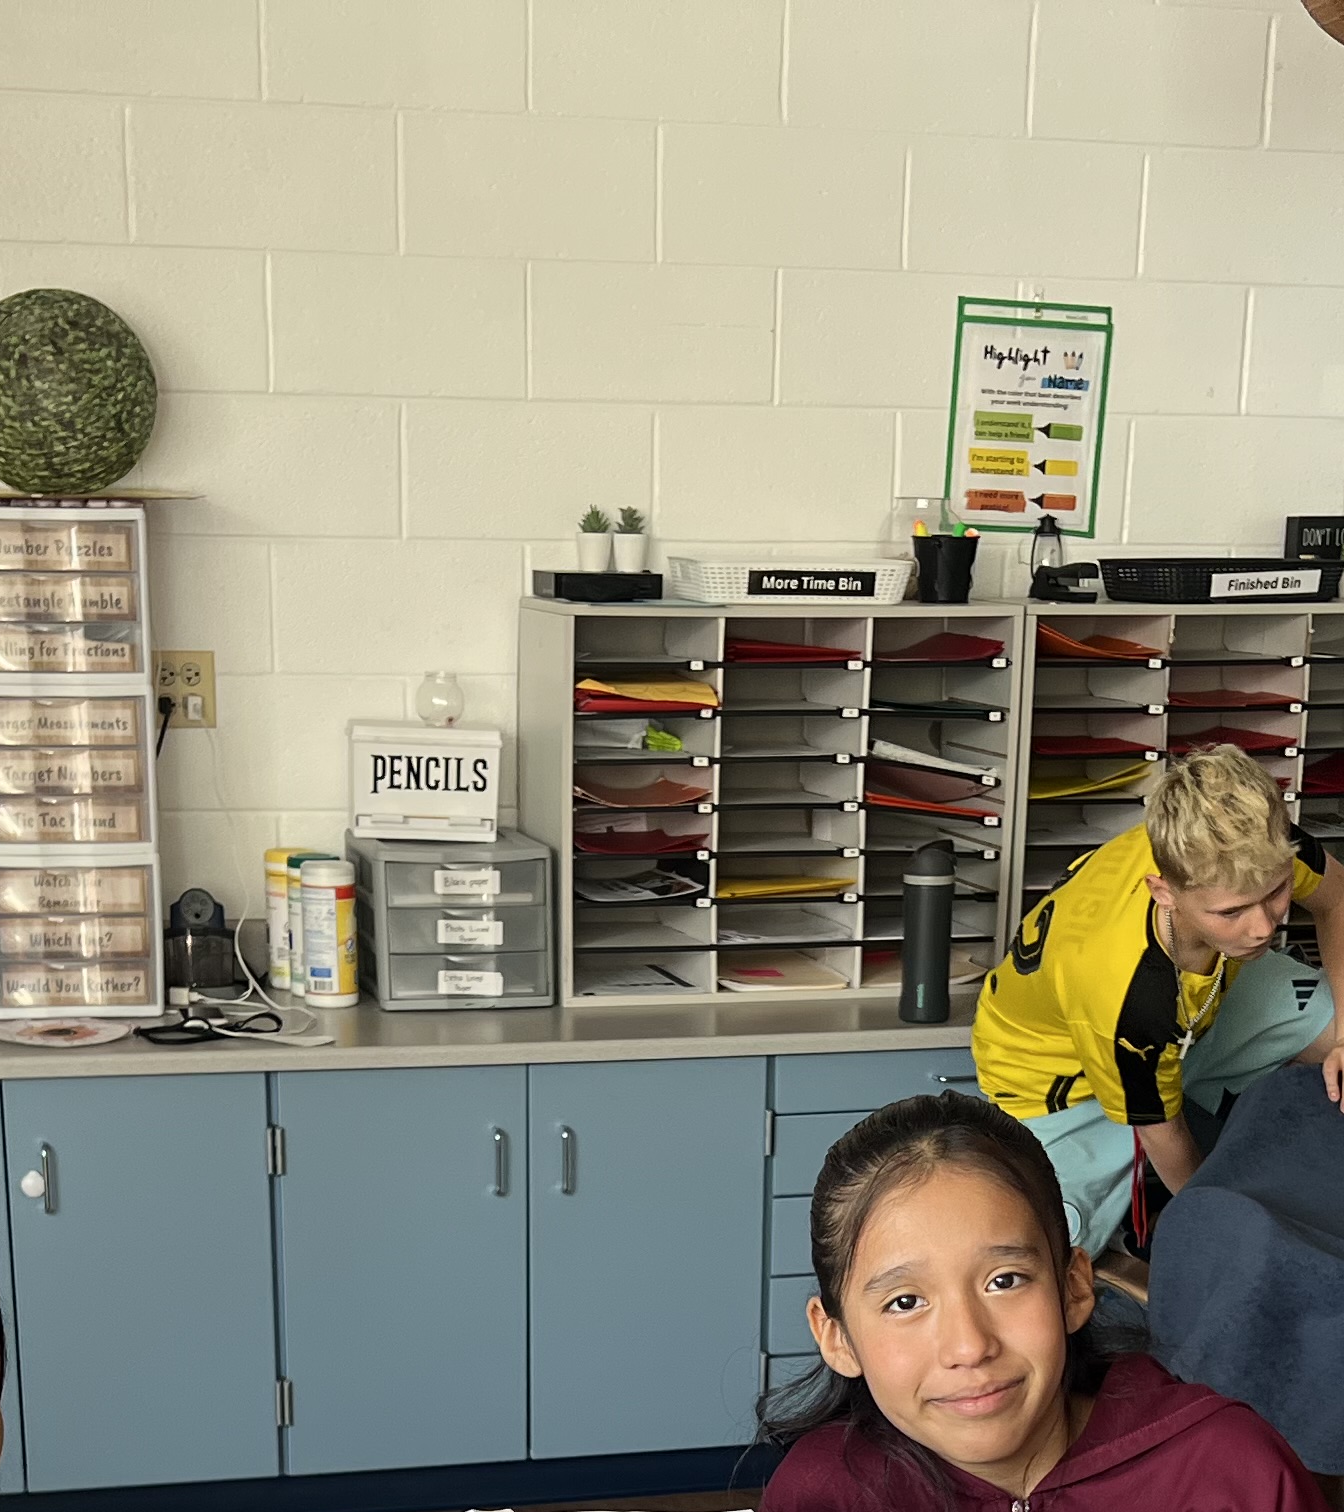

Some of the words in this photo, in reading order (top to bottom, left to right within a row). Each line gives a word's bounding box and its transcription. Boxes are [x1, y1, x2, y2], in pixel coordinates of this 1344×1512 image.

[984, 345, 1050, 371] Highlight
[1048, 375, 1084, 390] Name
[1303, 528, 1332, 546] DON'T
[762, 576, 798, 589] More
[801, 577, 836, 589] Time
[838, 577, 861, 590] Bin
[1228, 578, 1277, 591] Finished
[1282, 577, 1301, 589] Bin
[40, 641, 58, 656] for
[5, 765, 51, 783] Target
[370, 754, 488, 794] PENCILS
[39, 813, 65, 826] Tac
[30, 934, 71, 946] Which
[7, 980, 50, 993] Would
[56, 979, 80, 992] You
